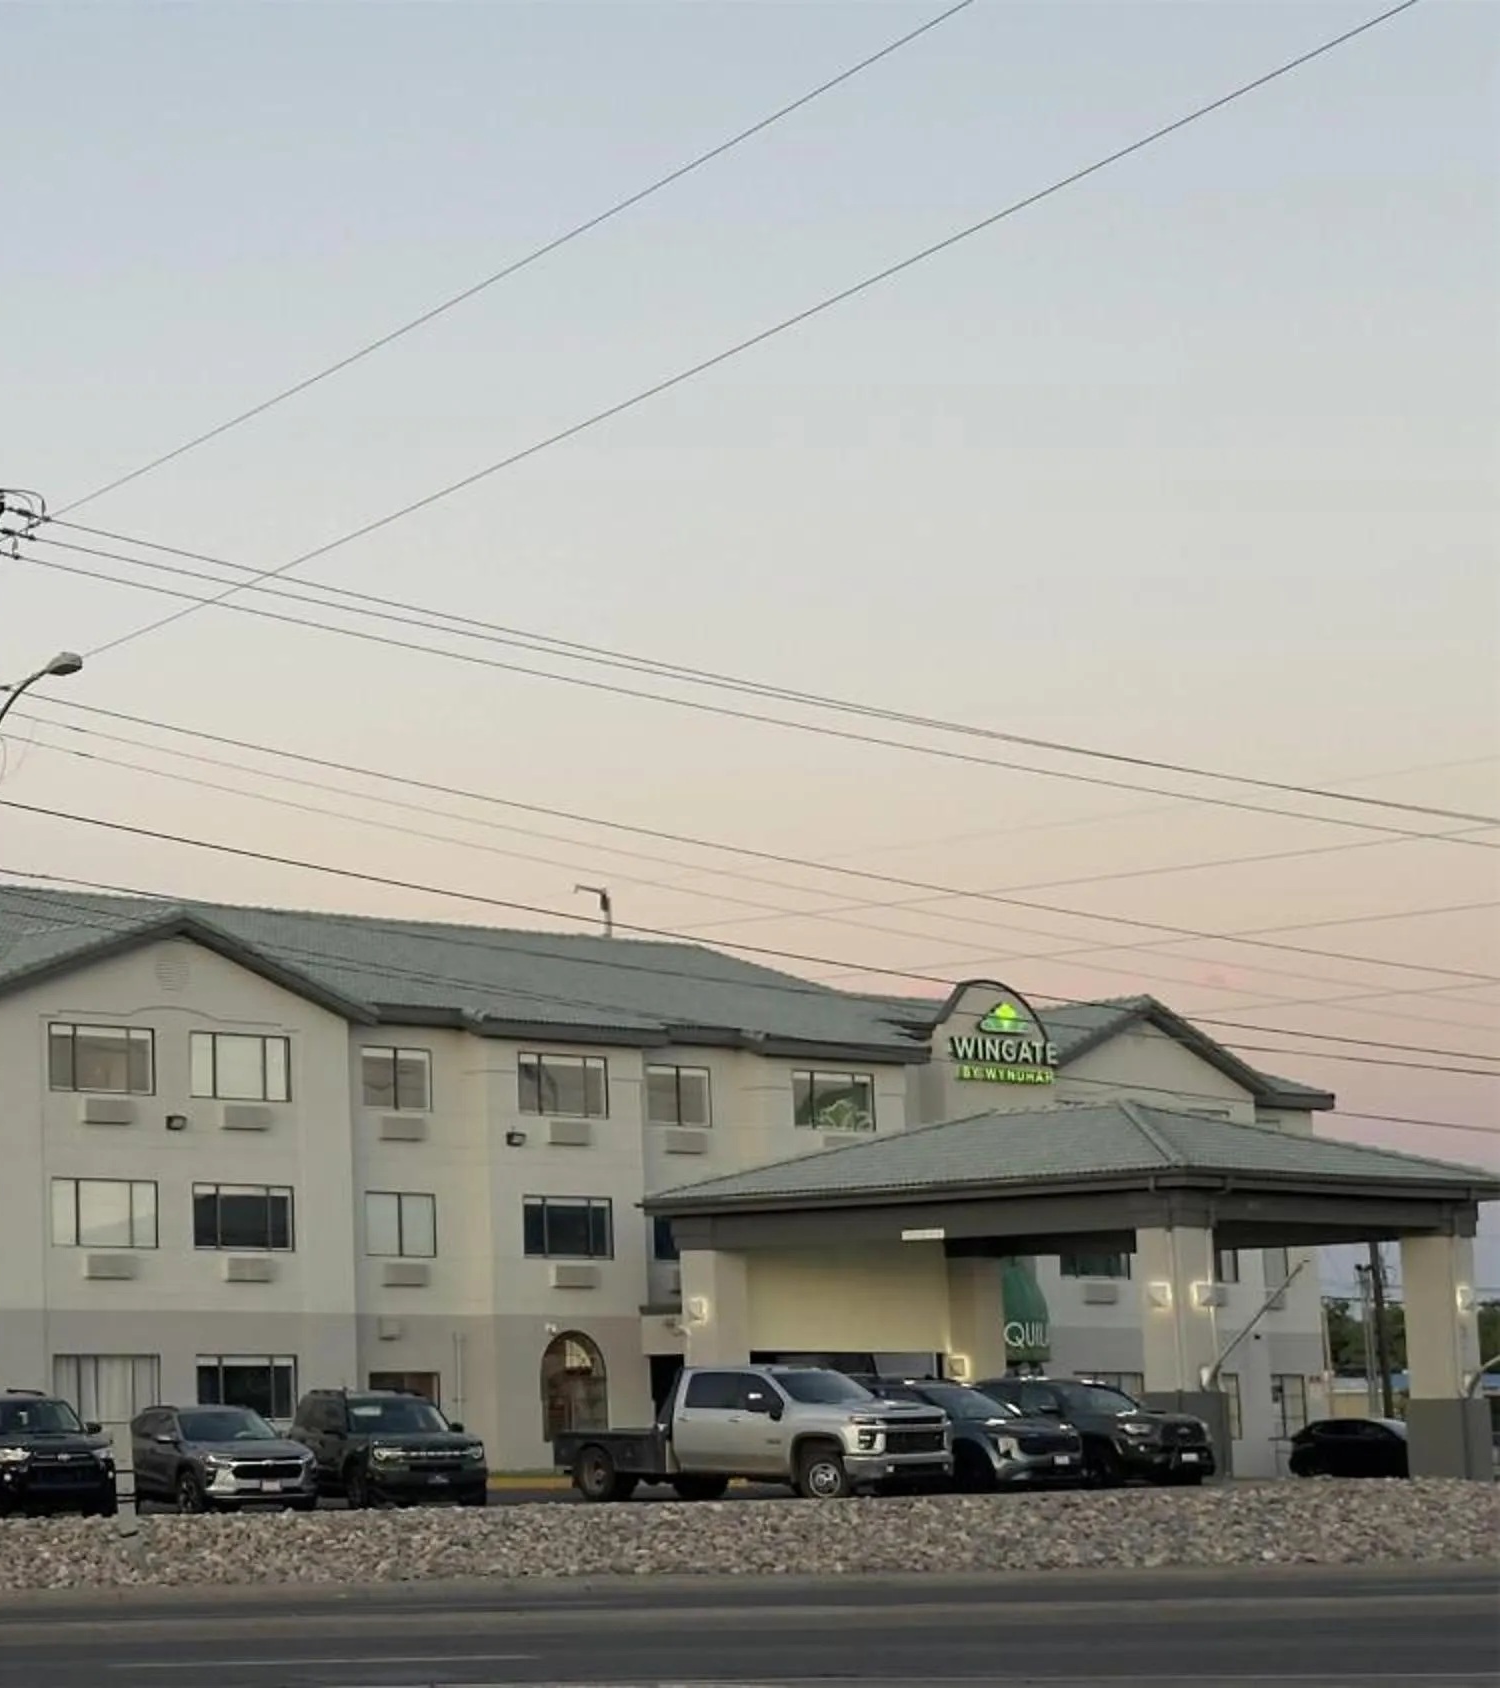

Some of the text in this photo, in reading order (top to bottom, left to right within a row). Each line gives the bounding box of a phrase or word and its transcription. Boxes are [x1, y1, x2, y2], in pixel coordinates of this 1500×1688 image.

[953, 1036, 1059, 1066] WINGATE
[962, 1065, 1054, 1084] BY WYNDHAM
